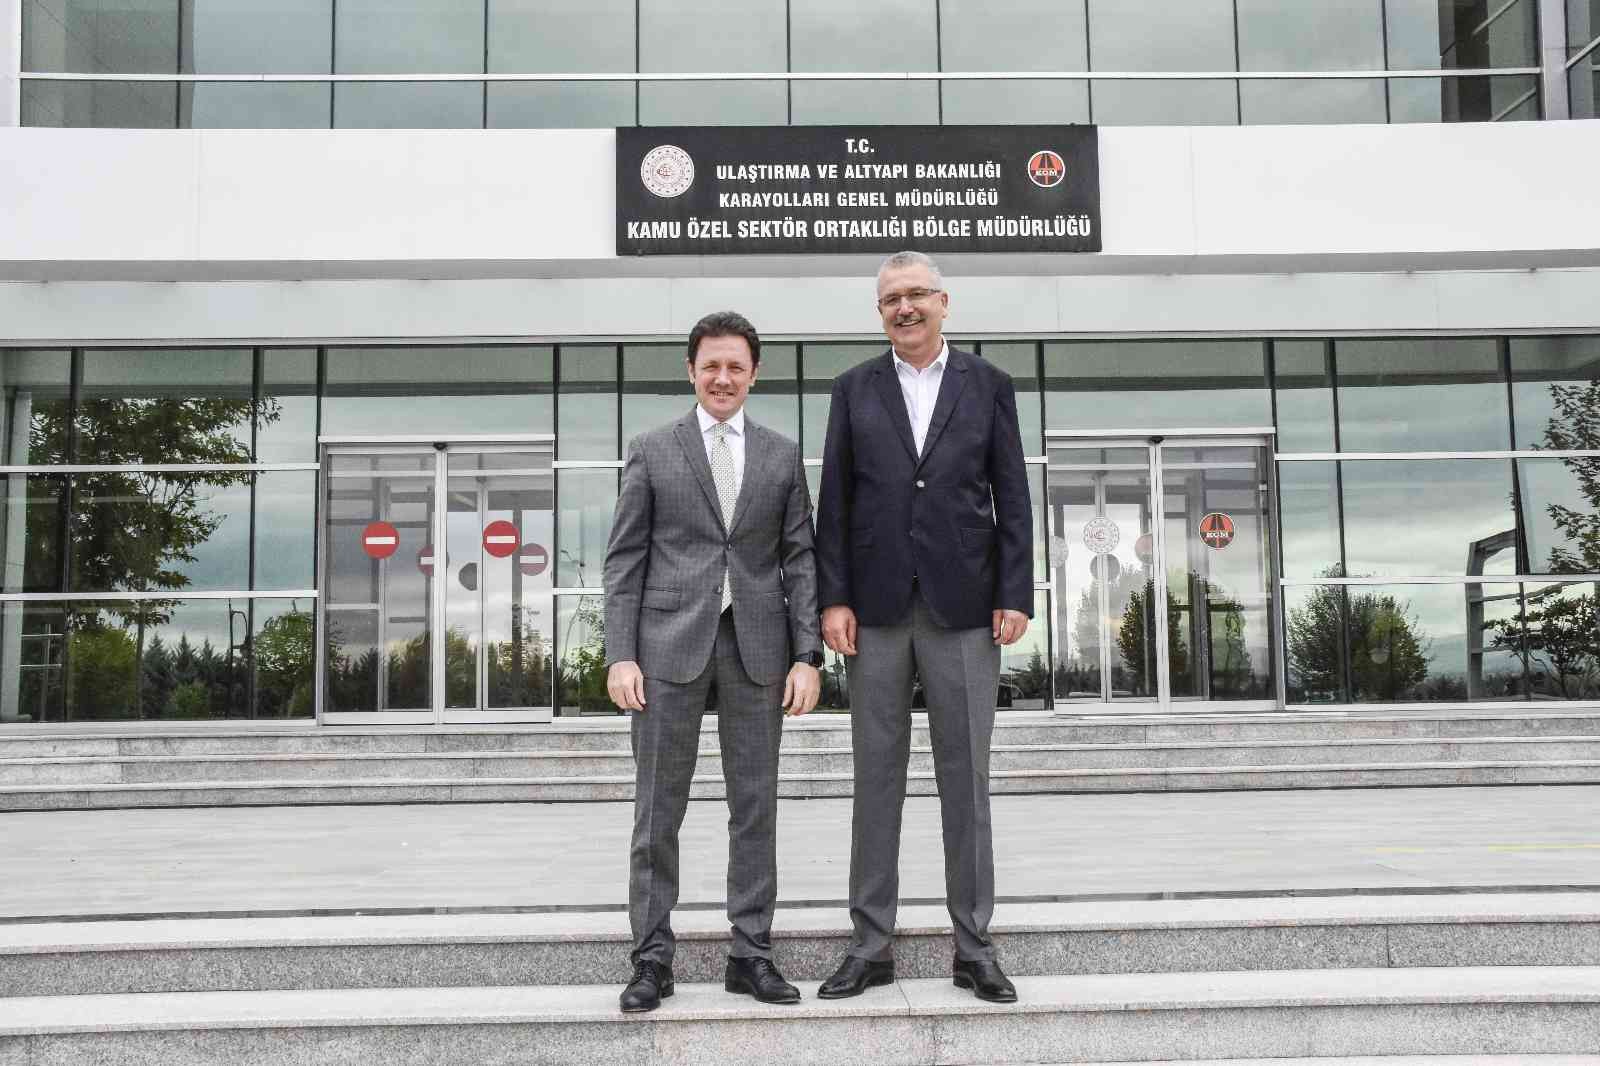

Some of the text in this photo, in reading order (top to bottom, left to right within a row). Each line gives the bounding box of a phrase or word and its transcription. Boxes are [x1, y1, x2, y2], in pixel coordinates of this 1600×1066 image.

[845, 138, 875, 154] T.C.
[716, 160, 1001, 184] ULAŞTIRMA VE ALTYAPI BAKANLIĞI
[719, 187, 999, 208] KARAYOLLARI GENEL MÜDÜRLÜĞÜ
[627, 214, 1091, 239] KAMU ÖZEL SEKTÖR ORTAKLIĞI BÖLGE MÜDÜRLÜĞÜ
